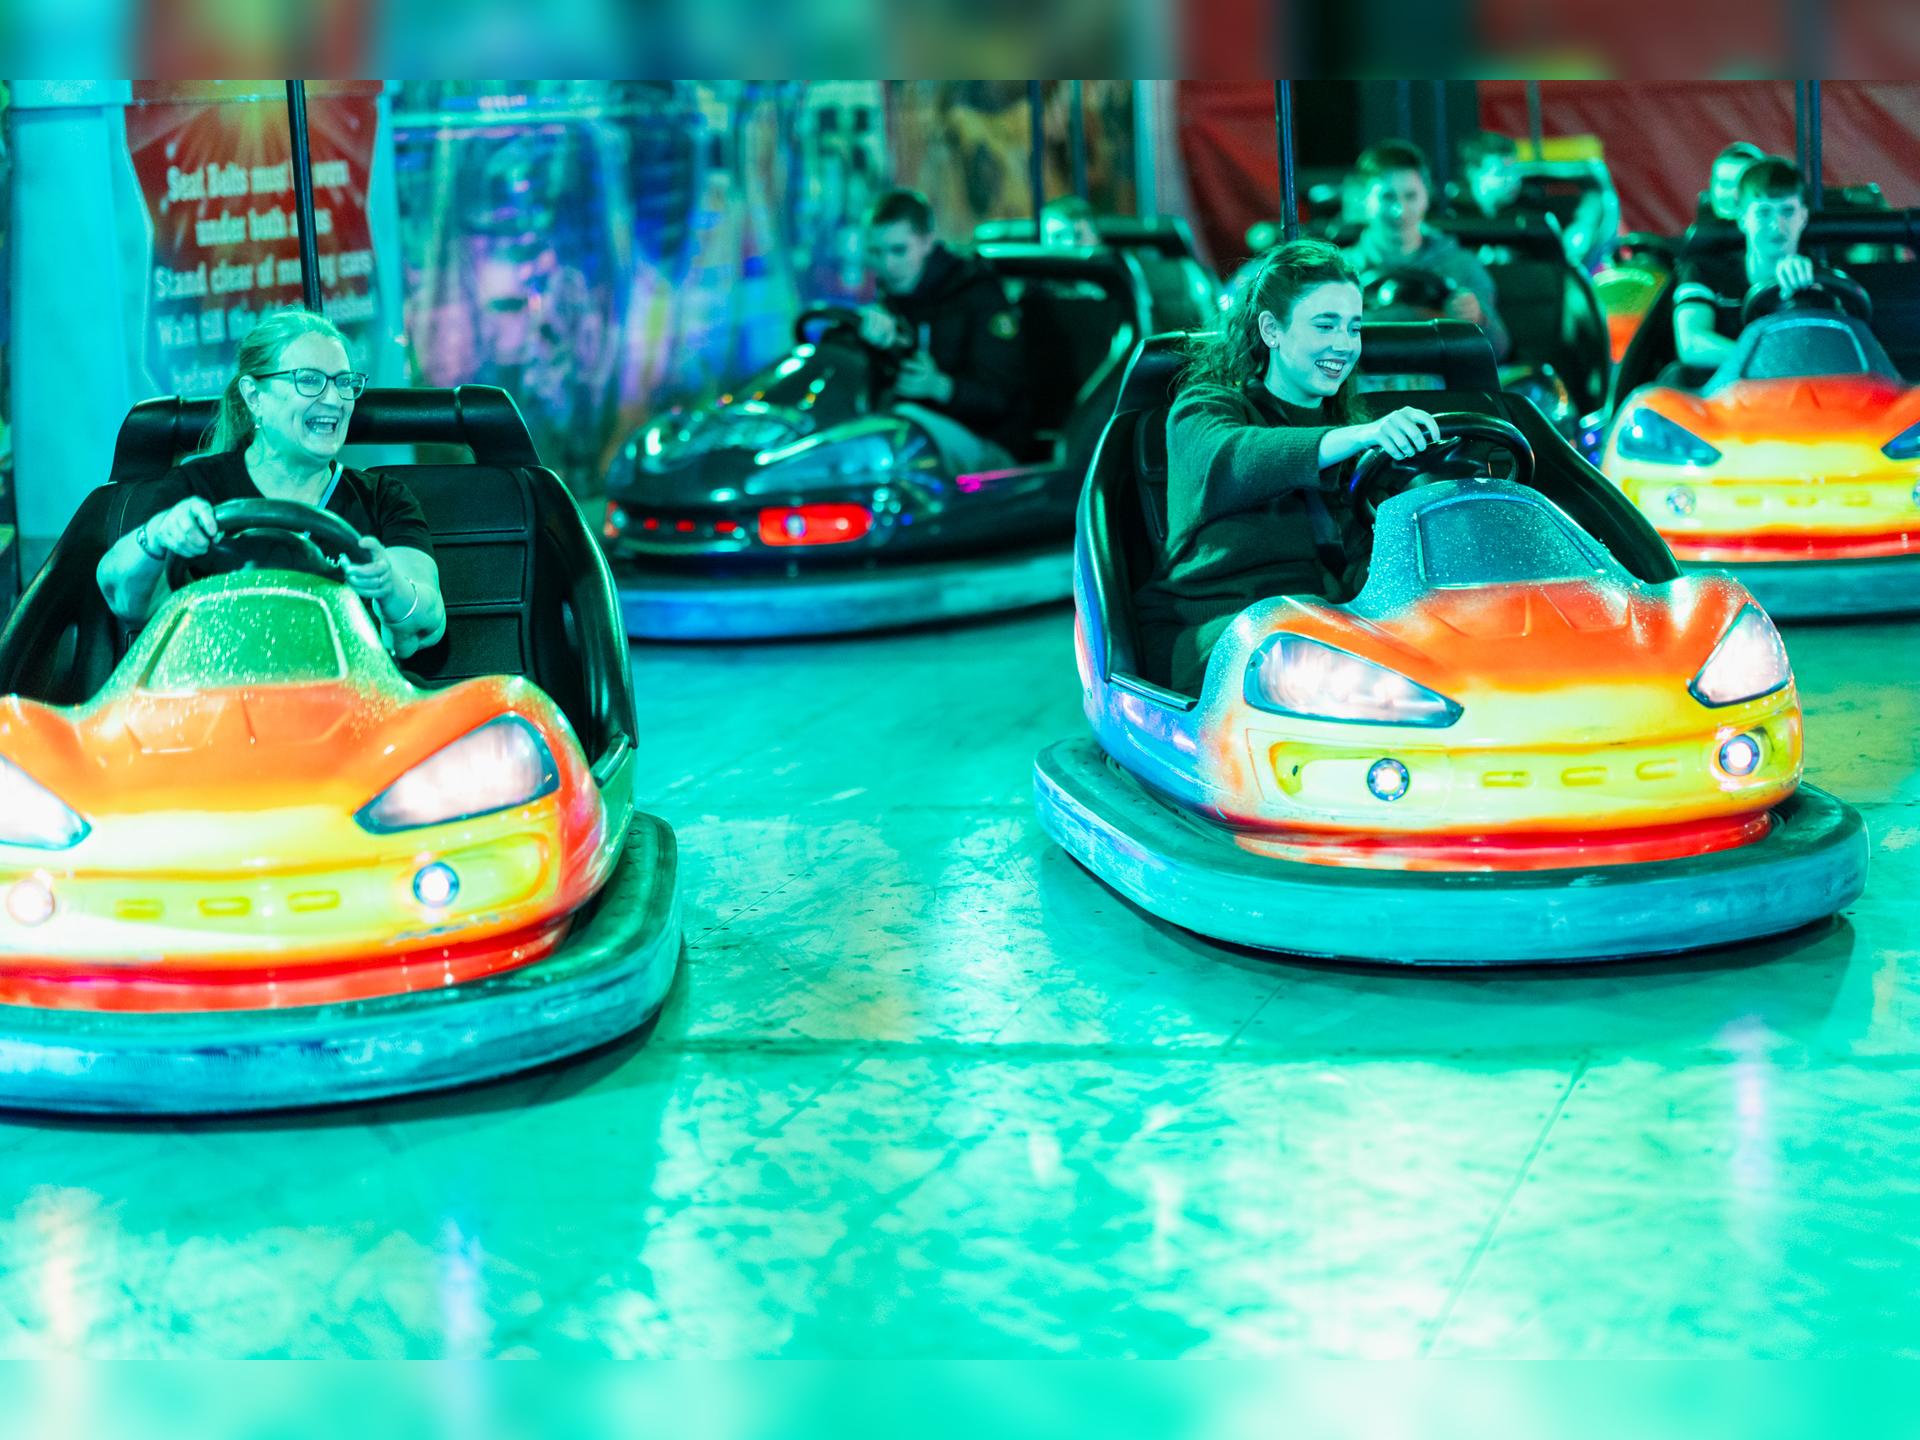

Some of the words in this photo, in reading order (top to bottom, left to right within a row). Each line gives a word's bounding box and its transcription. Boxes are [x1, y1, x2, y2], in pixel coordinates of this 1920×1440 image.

[167, 165, 206, 202] Seat
[195, 209, 246, 247] under
[248, 205, 288, 241] both
[290, 208, 333, 238] as
[154, 261, 208, 300] Stand
[210, 258, 253, 294] clear
[256, 253, 275, 289] of
[338, 250, 374, 278] cars
[157, 313, 197, 347] Wait
[200, 308, 226, 342] till
